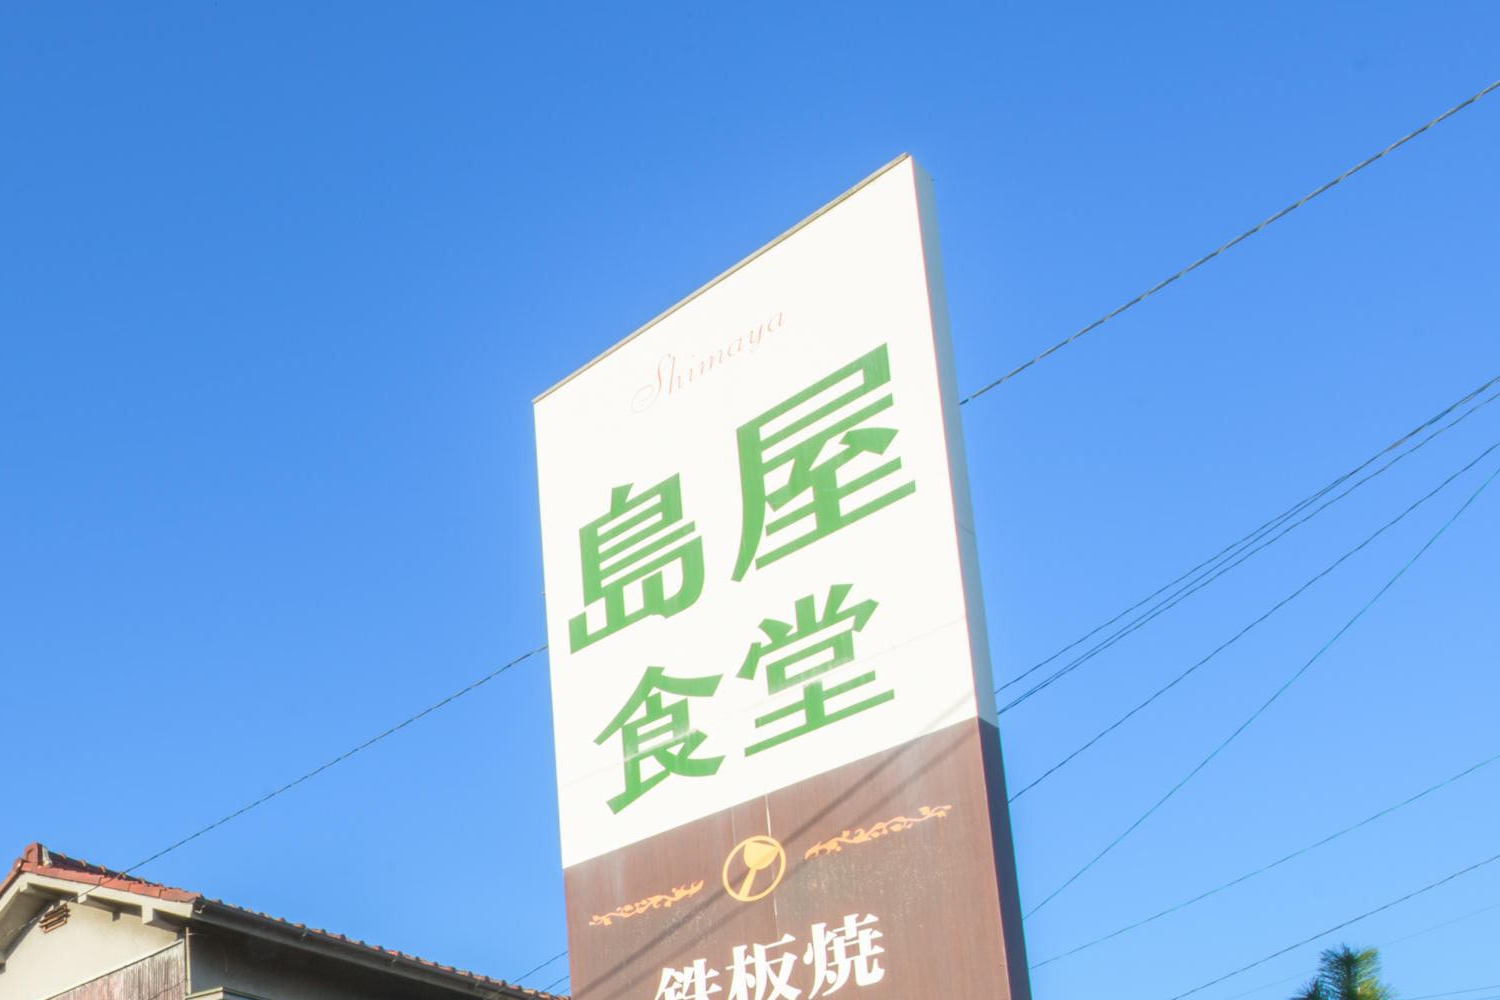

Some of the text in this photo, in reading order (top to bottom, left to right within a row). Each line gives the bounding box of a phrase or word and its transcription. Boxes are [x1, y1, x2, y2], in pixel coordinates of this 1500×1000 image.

[631, 311, 785, 413] Shimaya
[568, 341, 917, 655] 島屋
[593, 583, 895, 815] 食堂
